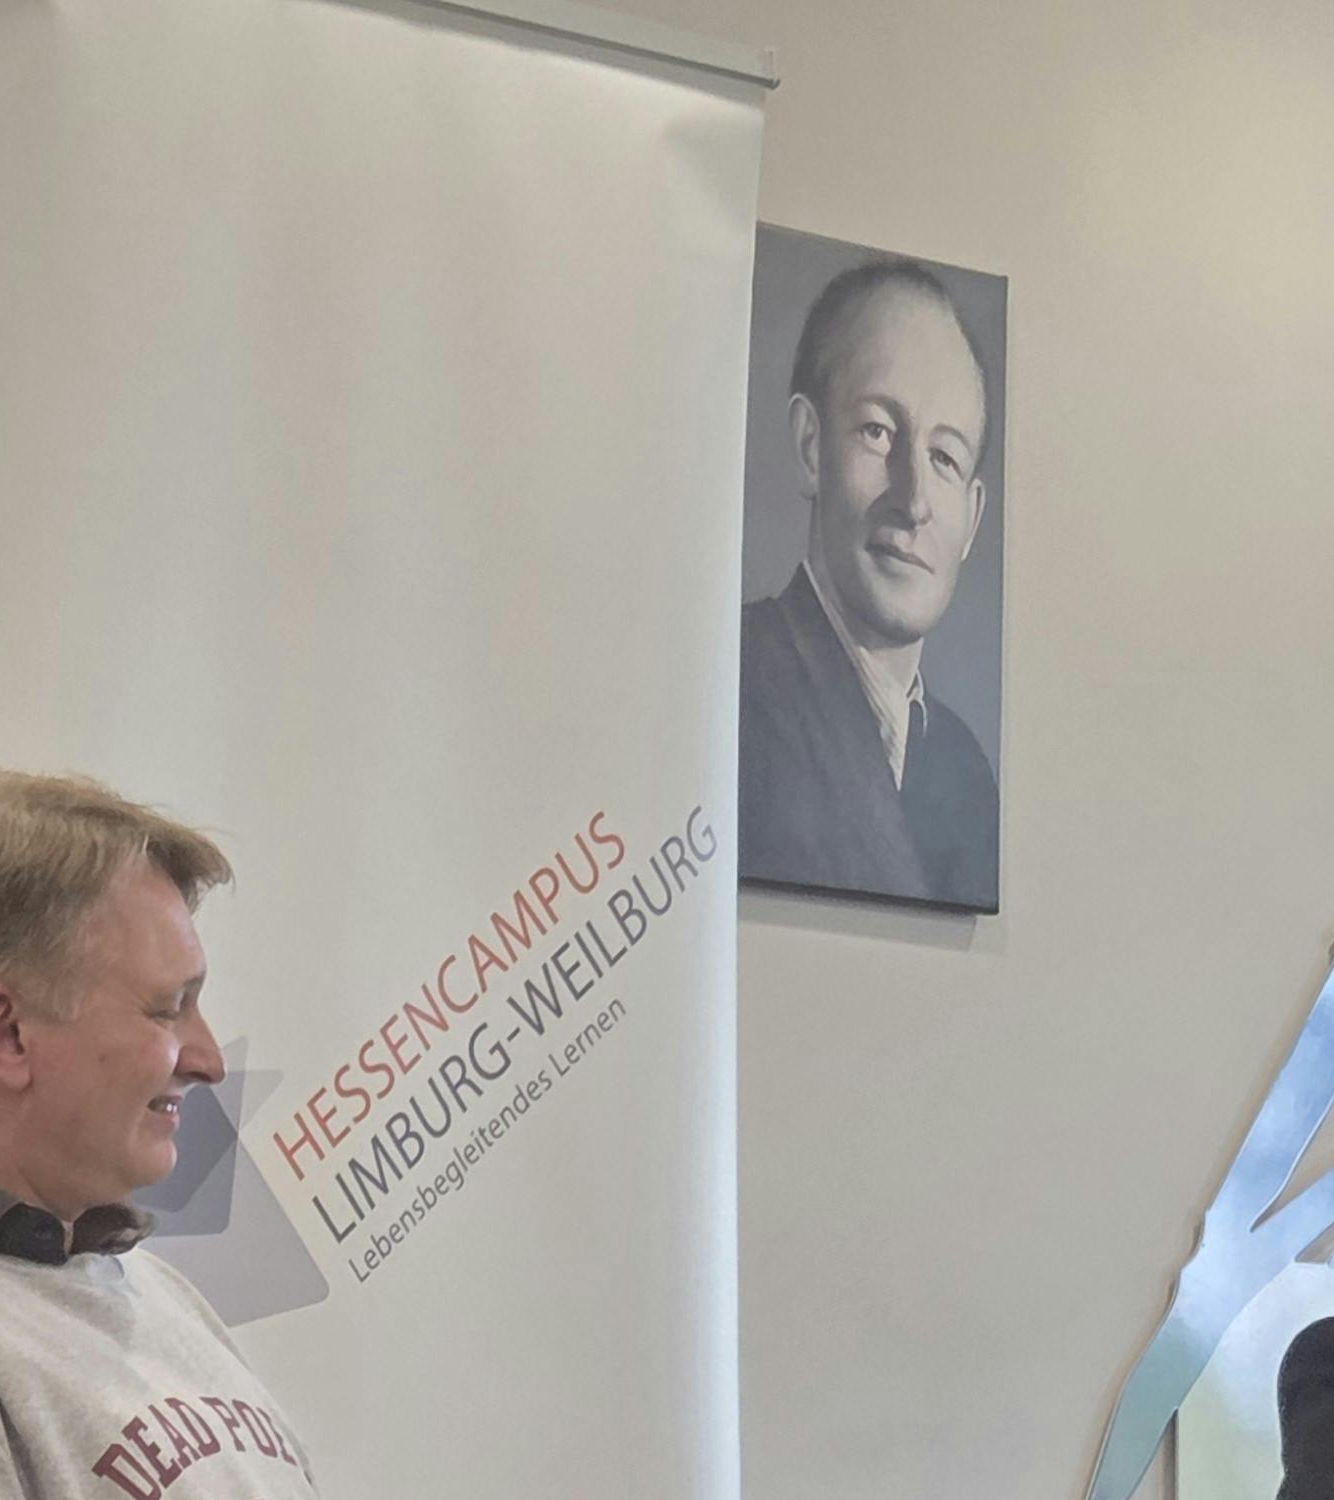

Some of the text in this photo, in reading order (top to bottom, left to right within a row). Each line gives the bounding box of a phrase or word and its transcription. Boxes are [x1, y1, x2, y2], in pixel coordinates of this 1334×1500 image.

[272, 810, 626, 1181] HESSENCAMPUS
[311, 805, 718, 1244] LIMBURG-WEILBURG
[348, 996, 628, 1284] Lebensbegleitendes Lernen
